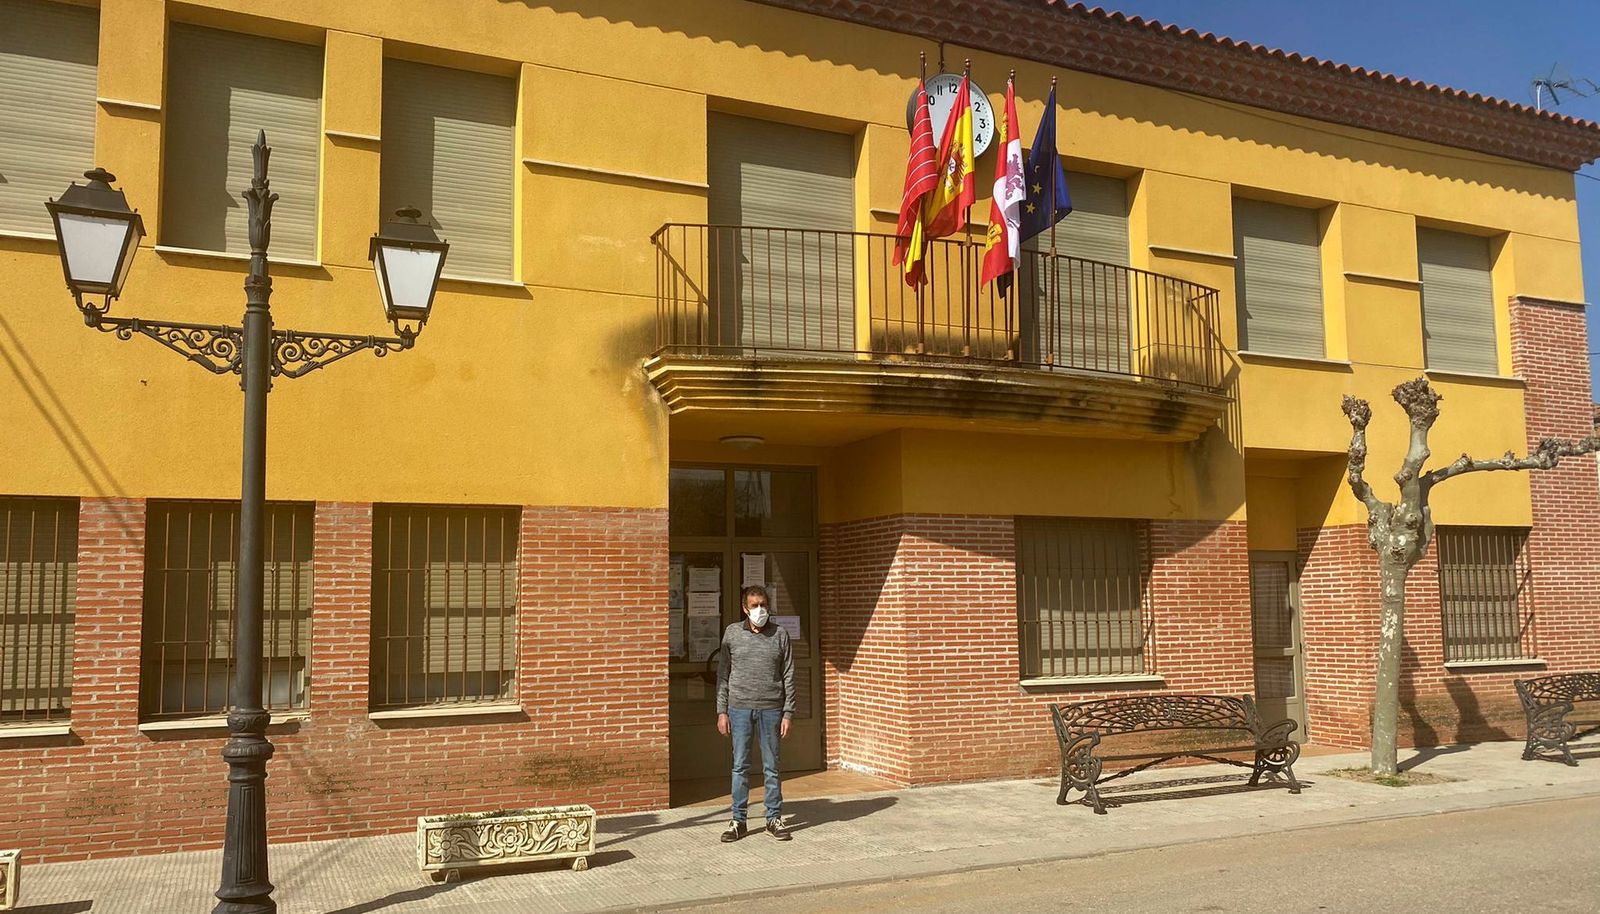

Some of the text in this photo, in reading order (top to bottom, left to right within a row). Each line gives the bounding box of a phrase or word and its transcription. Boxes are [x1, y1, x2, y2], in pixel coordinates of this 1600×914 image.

[937, 85, 943, 95] 11
[949, 83, 957, 93] 12
[974, 102, 980, 112] 2
[979, 119, 985, 128] 3
[975, 134, 982, 143] 4
